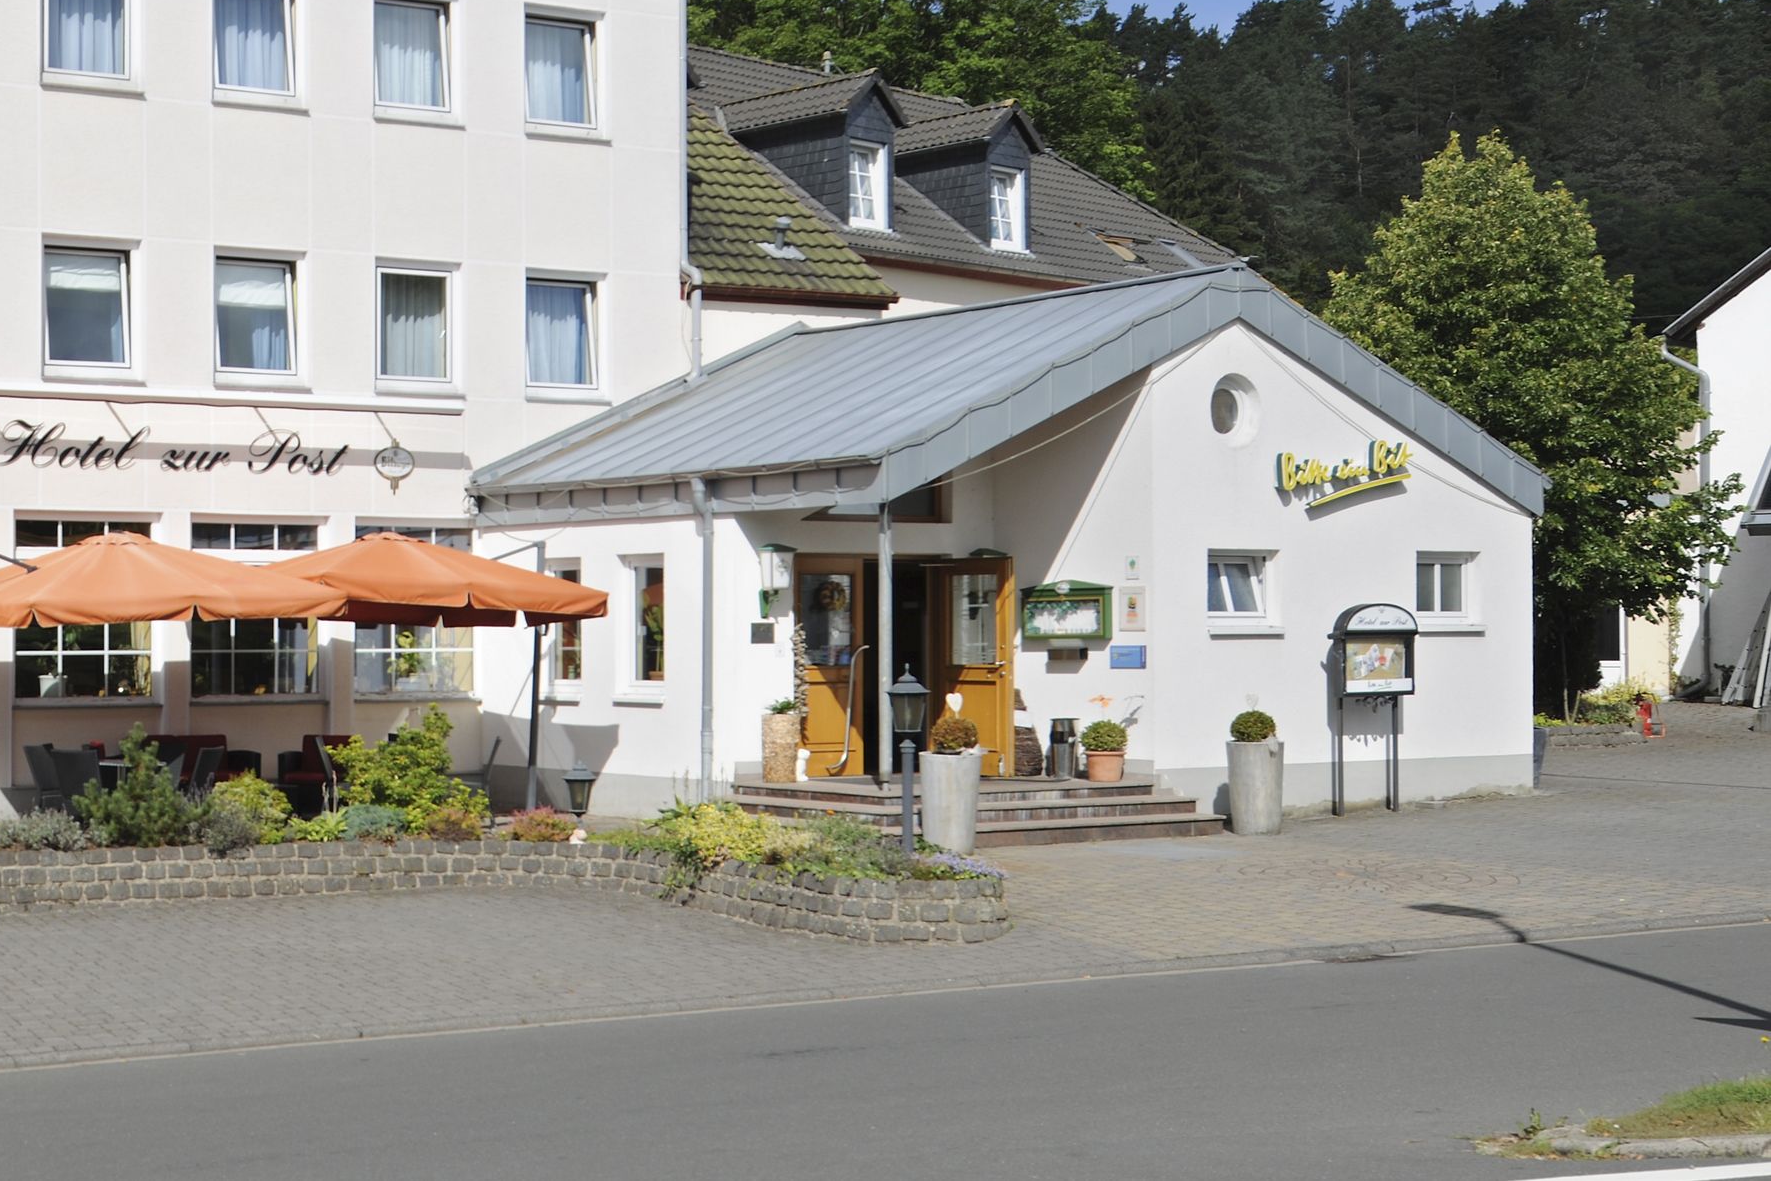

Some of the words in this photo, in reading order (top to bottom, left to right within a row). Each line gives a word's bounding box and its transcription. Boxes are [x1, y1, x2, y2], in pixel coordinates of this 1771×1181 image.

[159, 446, 231, 472] zur
[247, 428, 350, 476] Post
[1280, 452, 1332, 491] Bitte
[1371, 439, 1413, 474] Bit
